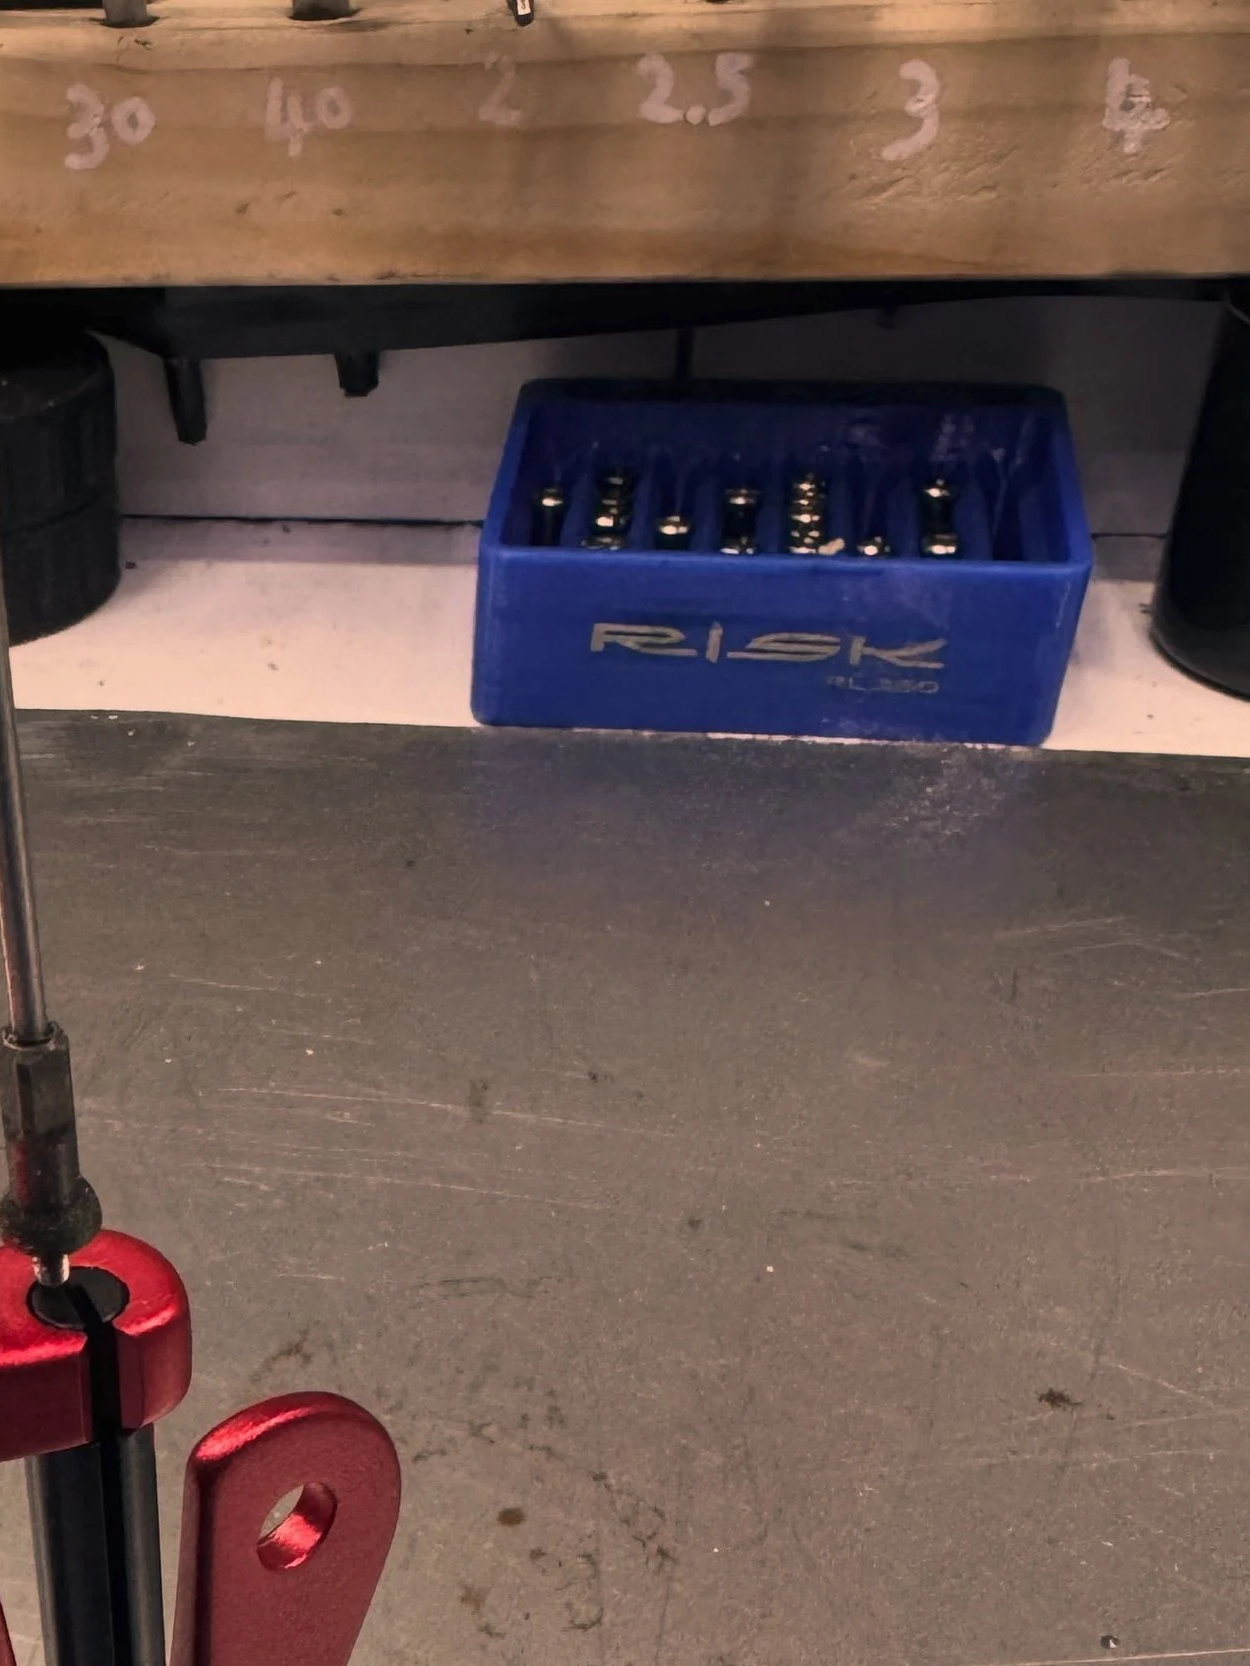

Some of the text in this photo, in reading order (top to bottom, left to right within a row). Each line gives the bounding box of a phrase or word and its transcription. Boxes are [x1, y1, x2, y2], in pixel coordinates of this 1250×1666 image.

[65, 83, 155, 170] 30
[265, 78, 351, 156] 40
[638, 52, 752, 126] 2.5
[881, 59, 939, 160] 3
[1103, 57, 1171, 154] 4
[590, 622, 948, 669] RISK
